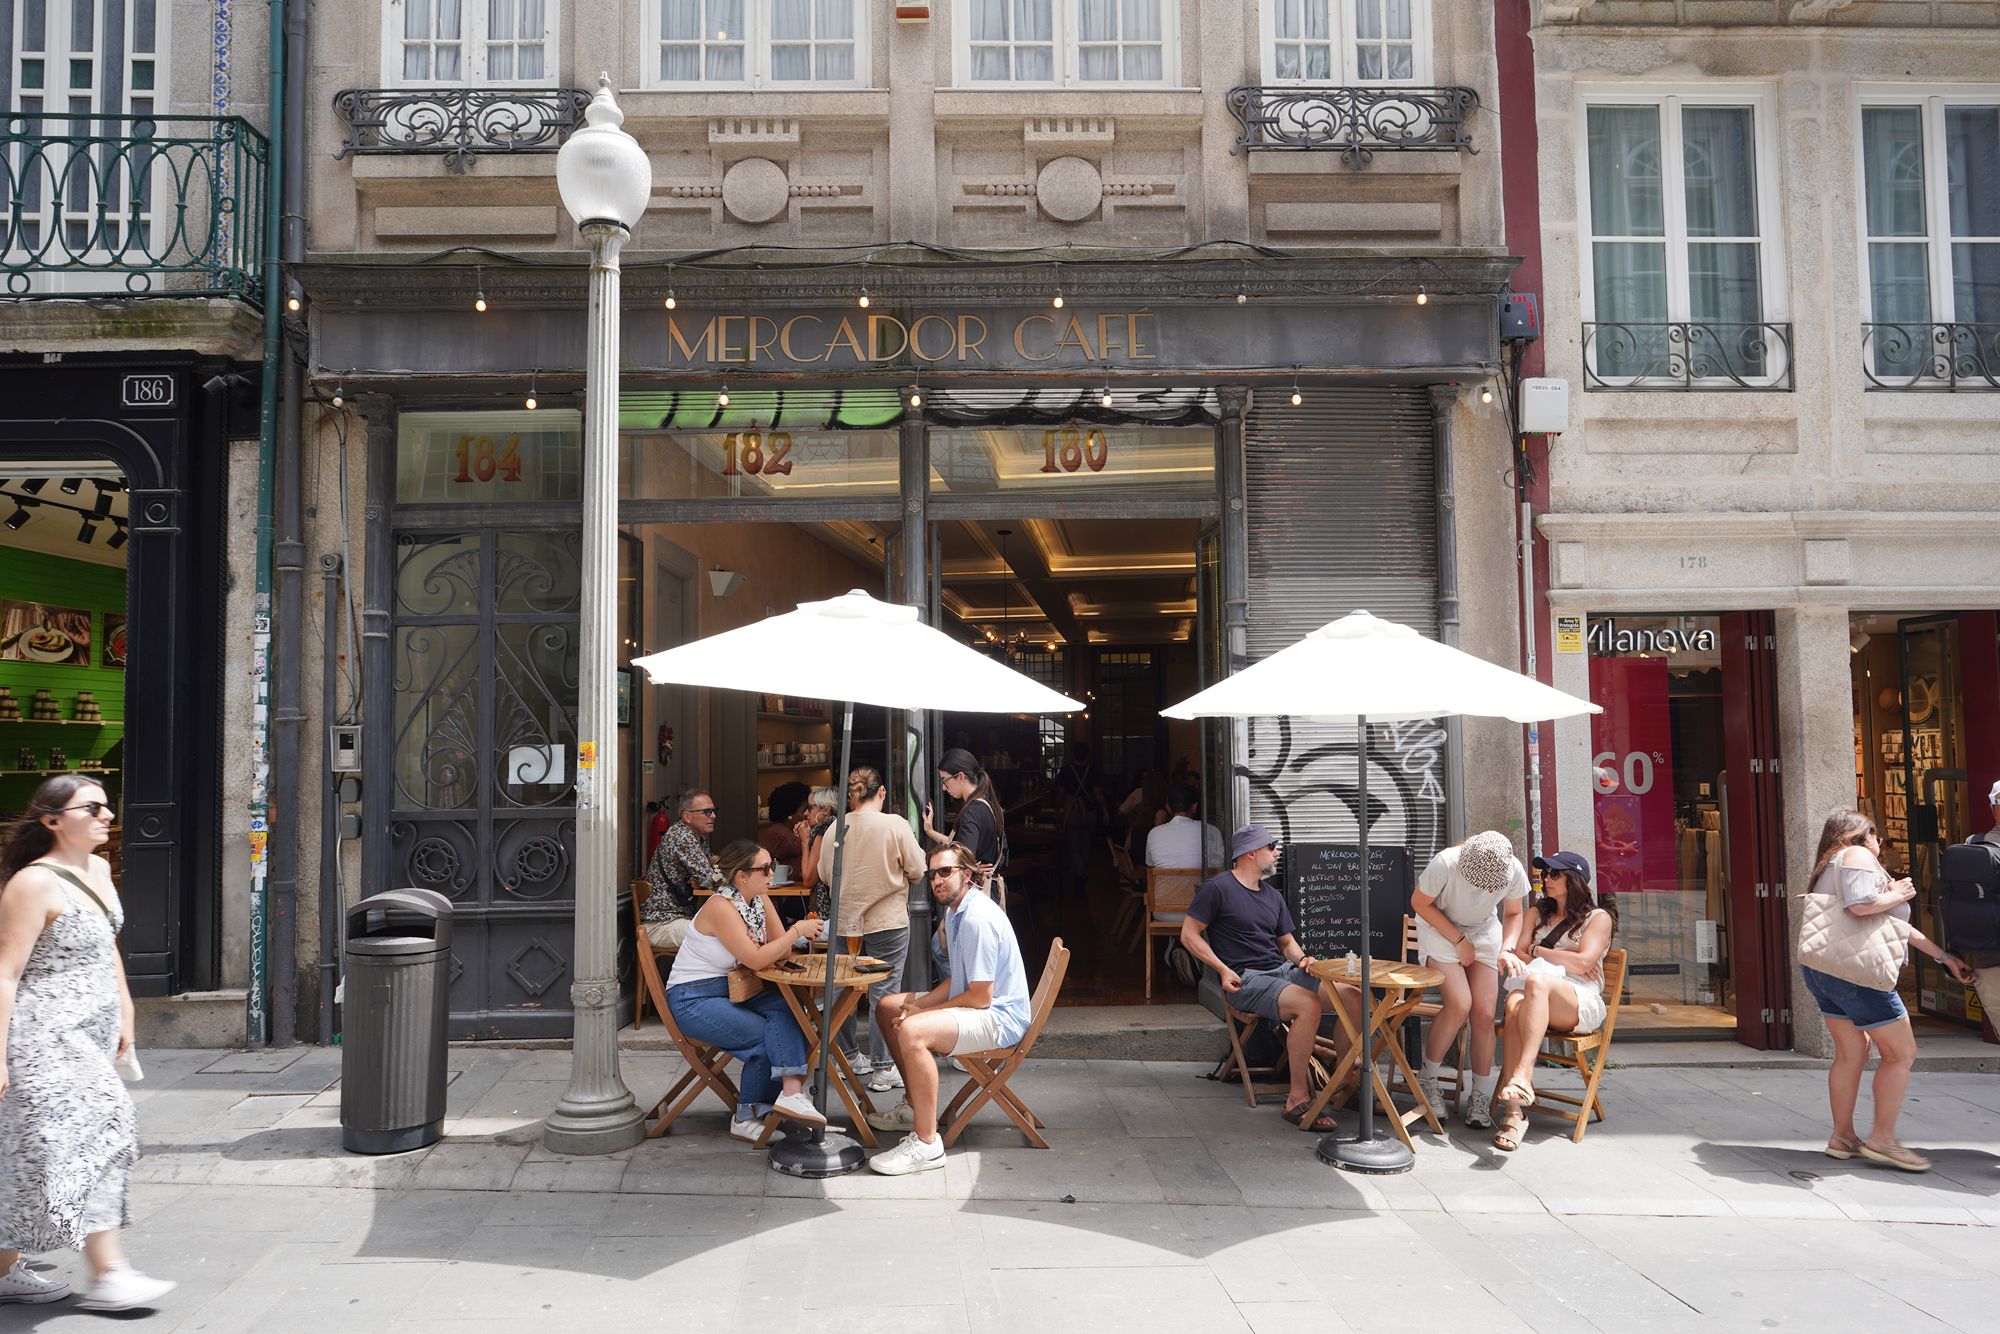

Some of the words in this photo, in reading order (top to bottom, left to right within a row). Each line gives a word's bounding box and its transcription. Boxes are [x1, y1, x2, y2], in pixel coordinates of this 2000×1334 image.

[667, 315, 988, 362] MERCADOR
[1013, 307, 1156, 362] CAFÉ
[133, 380, 163, 400] 186
[453, 434, 522, 483] 184
[723, 432, 793, 475] 182
[1040, 429, 1108, 472] 180
[1680, 556, 1708, 569] 178
[1370, 850, 1386, 860] AFÉ
[1347, 862, 1386, 871] BREAST
[1345, 917, 1361, 925] STYL
[1369, 930, 1384, 938] ICES
